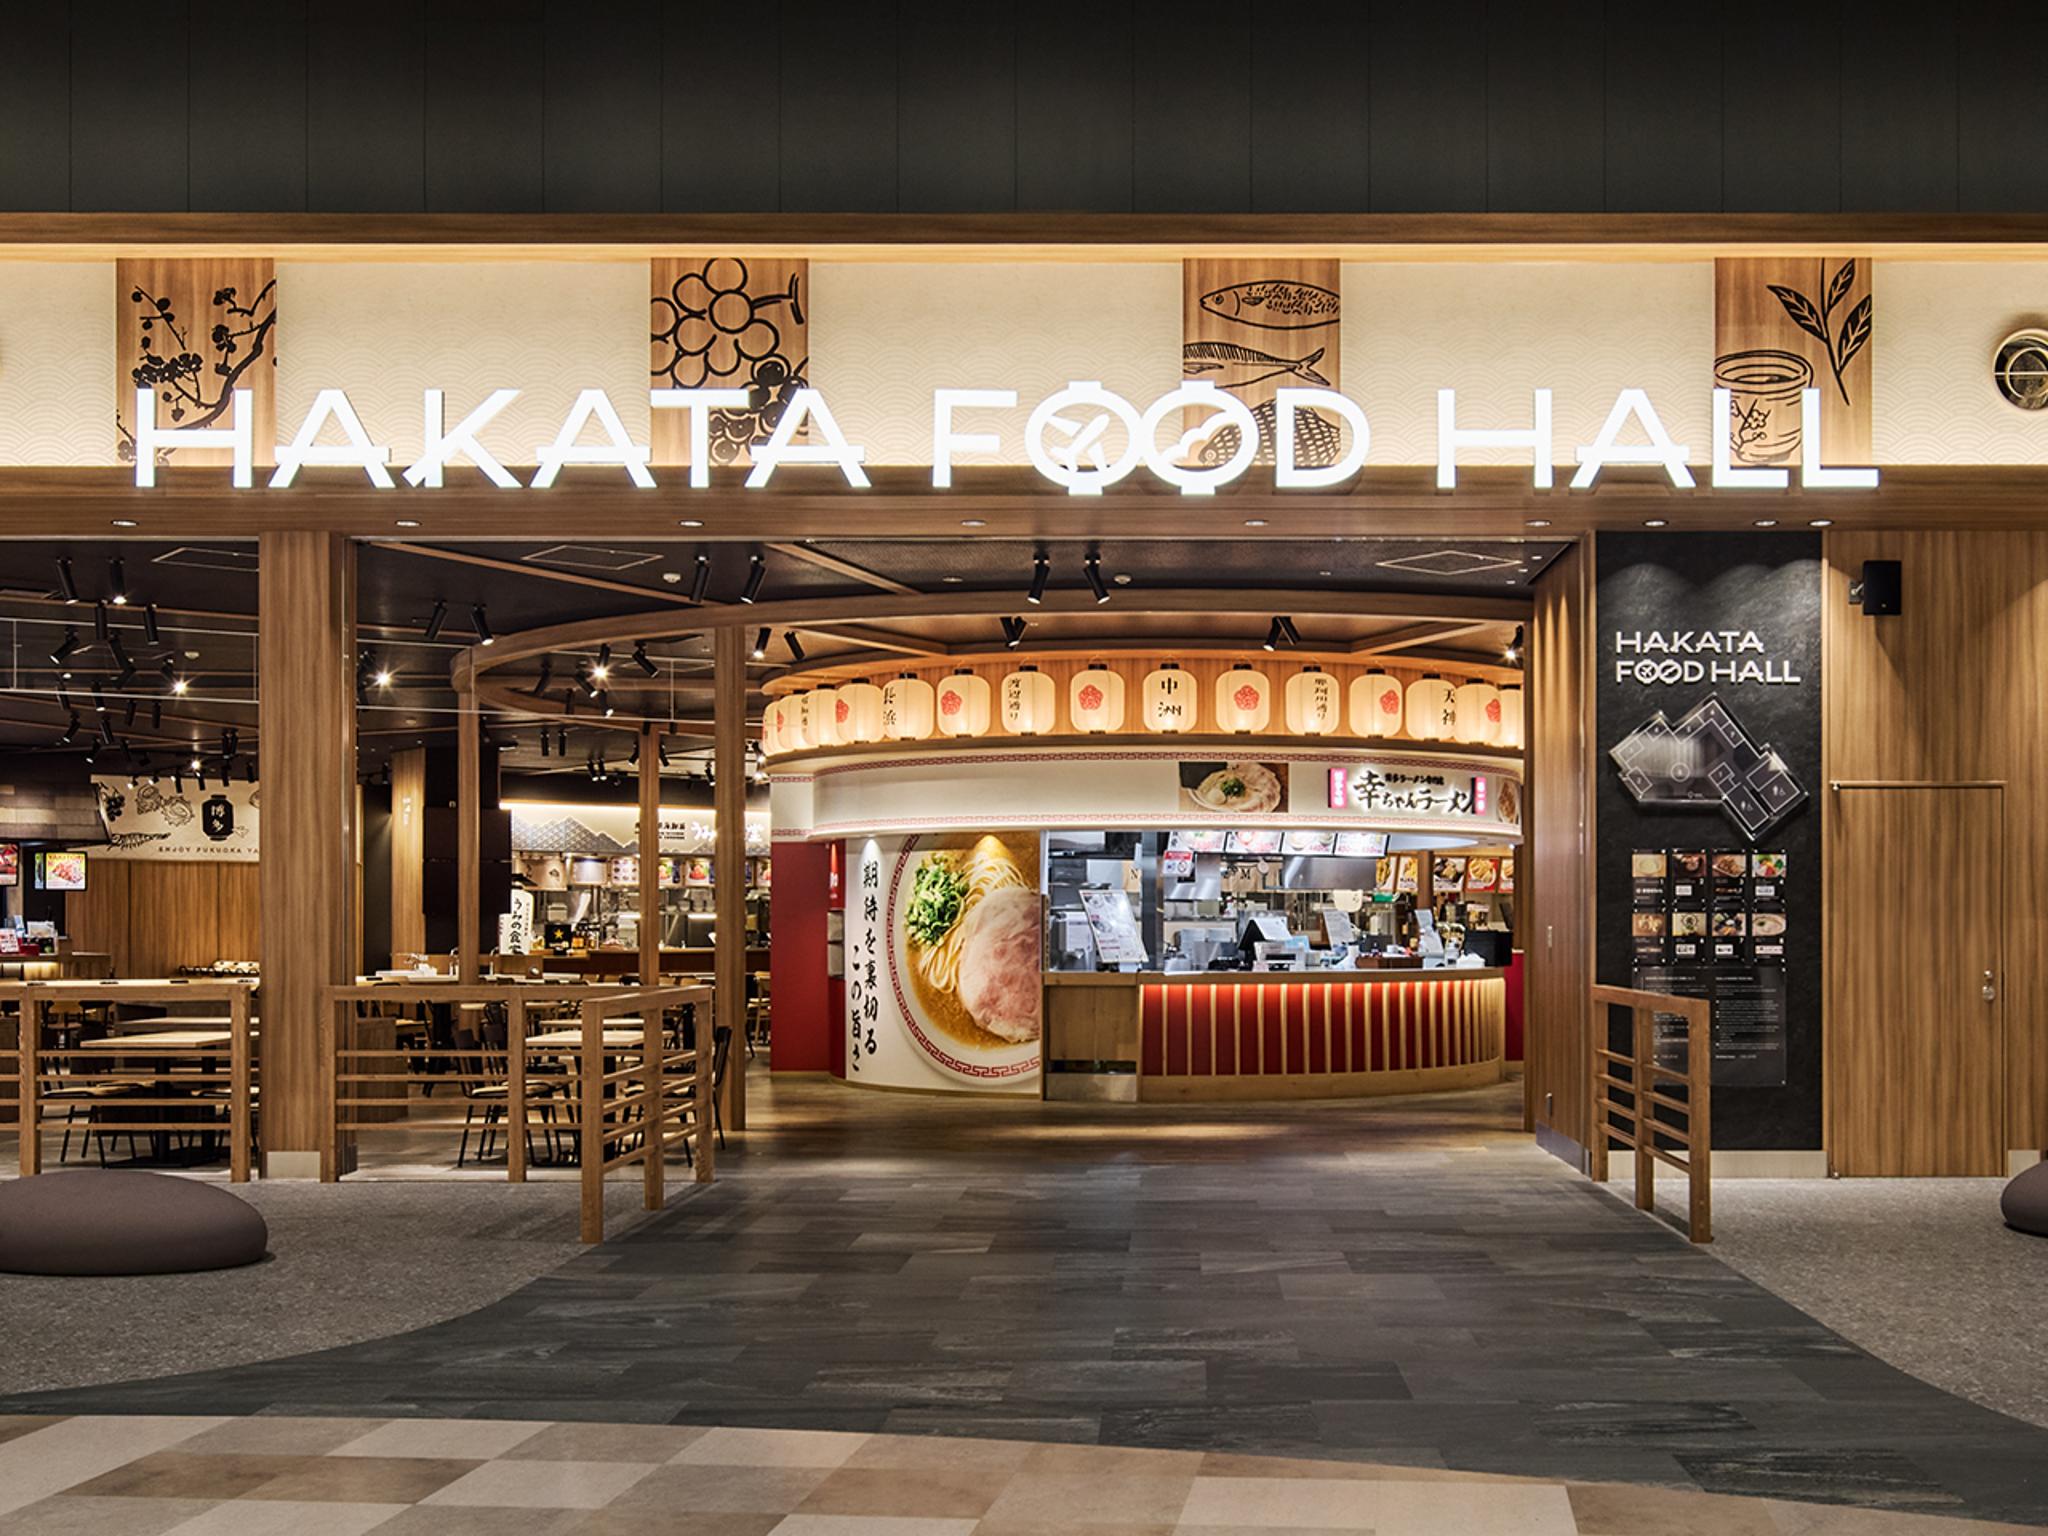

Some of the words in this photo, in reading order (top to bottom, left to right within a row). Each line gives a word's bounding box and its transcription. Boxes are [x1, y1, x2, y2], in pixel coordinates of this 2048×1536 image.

[134, 388, 872, 489] HAKATA
[932, 380, 1371, 496] FOOD
[1436, 388, 1881, 490] HALL
[1615, 630, 1765, 654] HAKATA
[1615, 658, 1705, 685] FOOD
[1710, 659, 1802, 684] HALL
[1157, 677, 1182, 717] 中洲
[210, 803, 226, 833] 博多
[863, 860, 879, 1056] 期待を裏切る
[851, 944, 863, 1072] この旨さ
